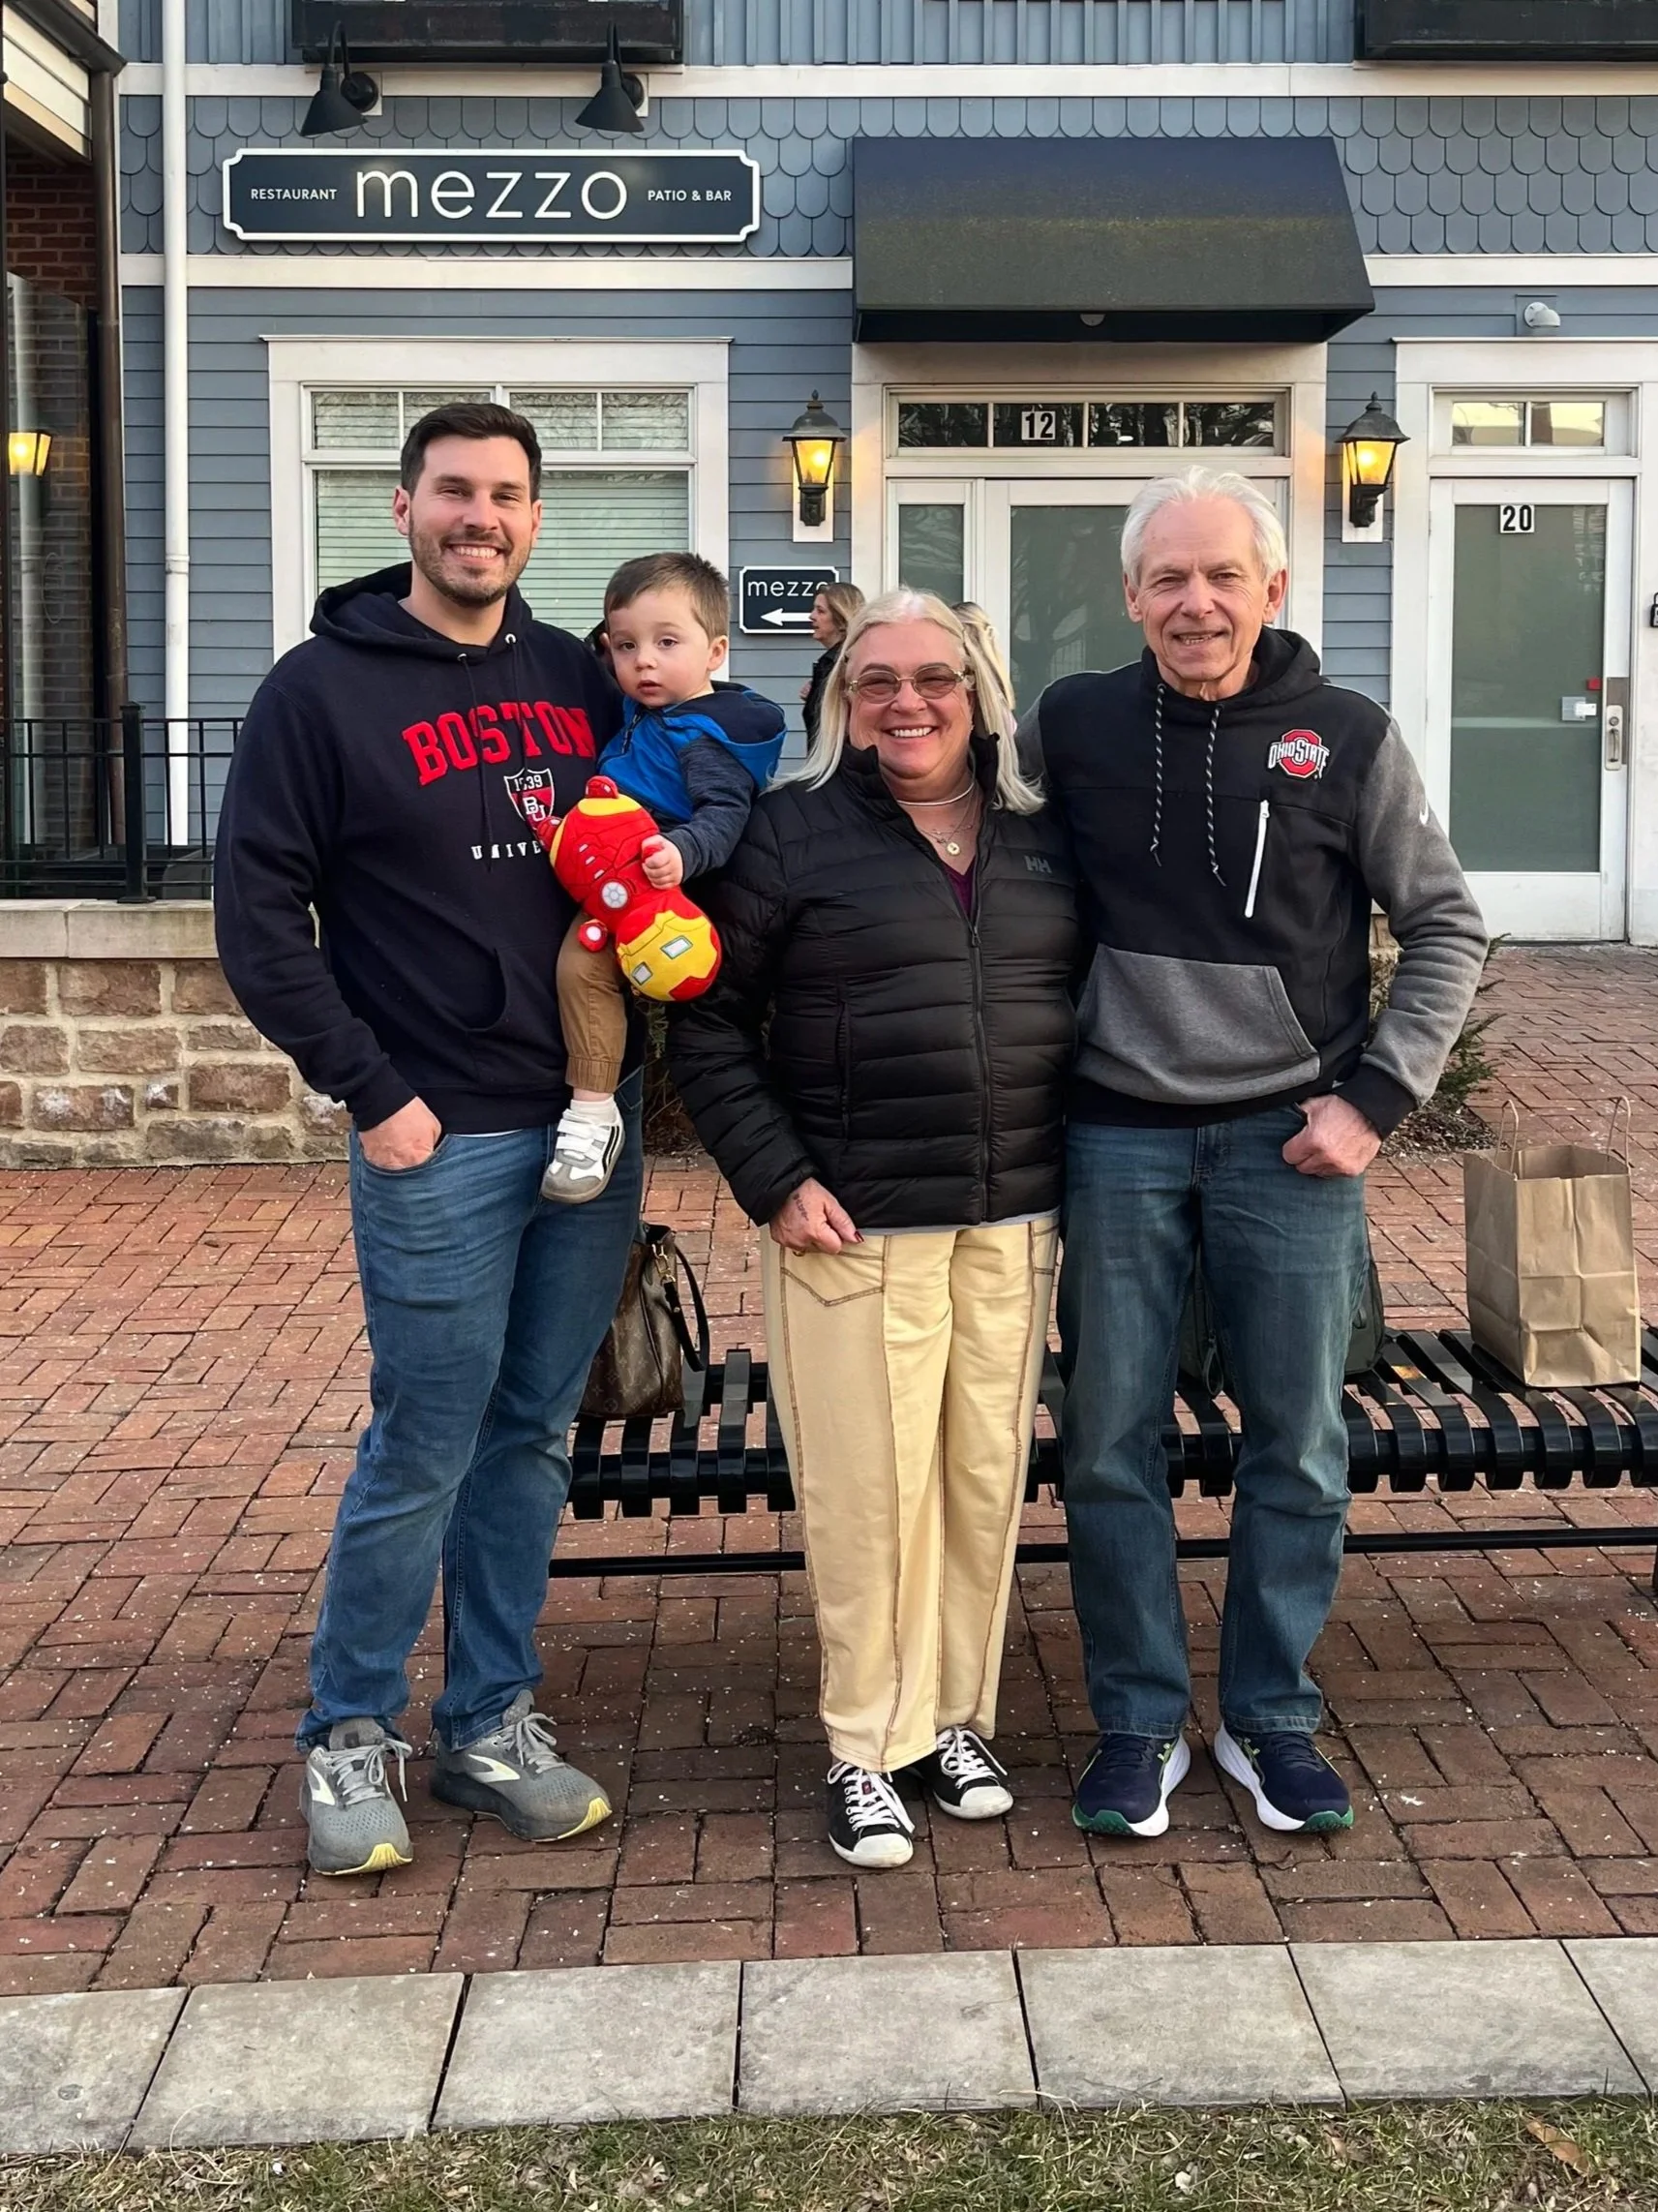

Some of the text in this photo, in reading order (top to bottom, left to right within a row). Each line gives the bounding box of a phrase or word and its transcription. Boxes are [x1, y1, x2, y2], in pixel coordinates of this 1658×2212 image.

[250, 188, 338, 200] RESTAURANT
[356, 170, 628, 221] mezzo
[648, 190, 732, 201] PATIO & BAR
[1025, 411, 1053, 439] 12
[1502, 504, 1532, 531] 20
[402, 701, 597, 786] BOSTON
[1268, 739, 1330, 773] OHIO STATE
[523, 796, 547, 822] BU
